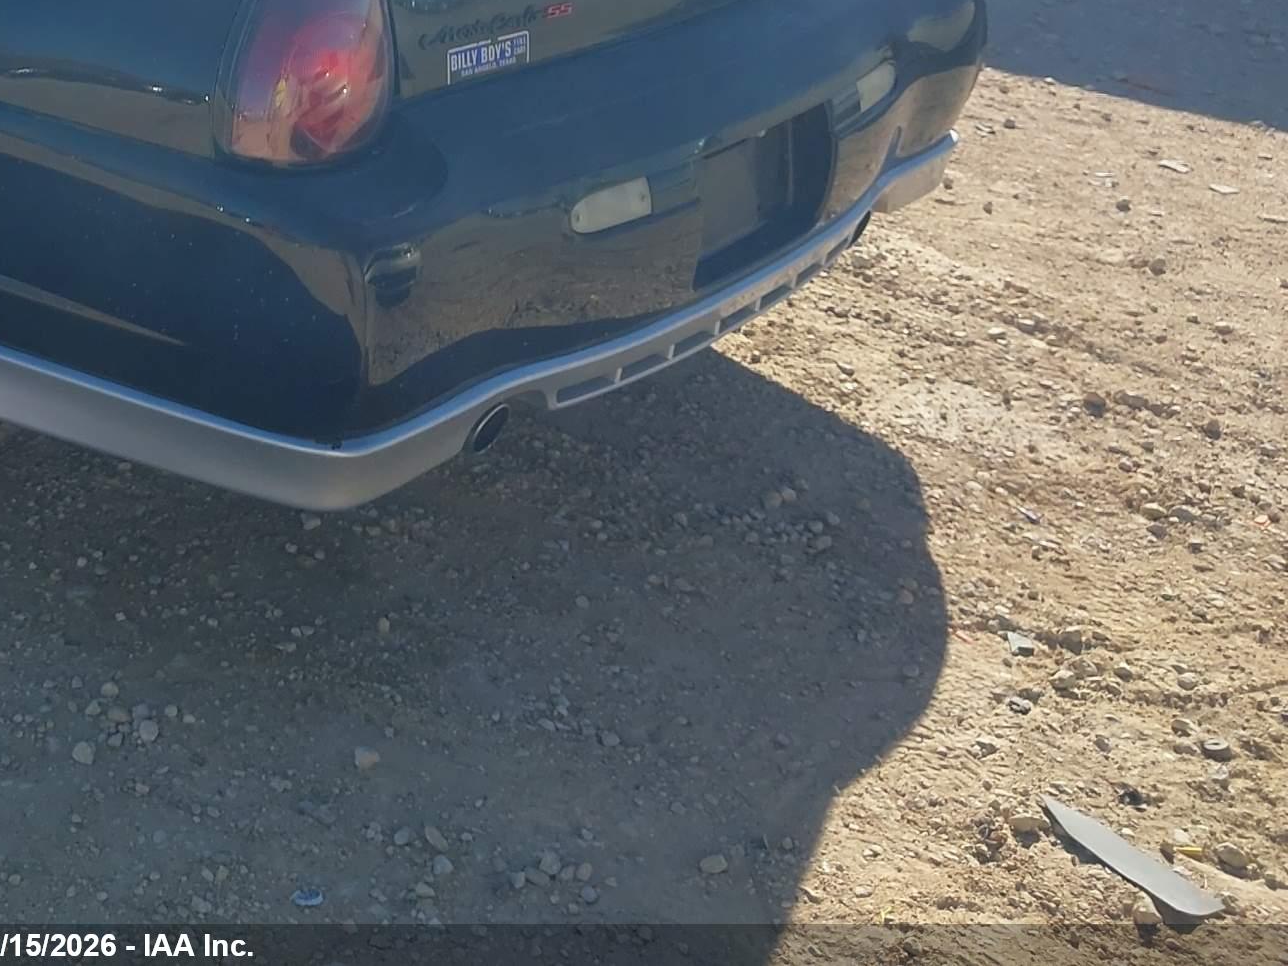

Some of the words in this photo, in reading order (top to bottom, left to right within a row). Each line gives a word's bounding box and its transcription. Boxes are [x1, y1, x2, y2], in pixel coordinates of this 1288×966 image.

[544, 1, 573, 19] SS
[451, 48, 478, 72] BILLY
[480, 40, 511, 64] BOY'S
[461, 65, 473, 77] SAN
